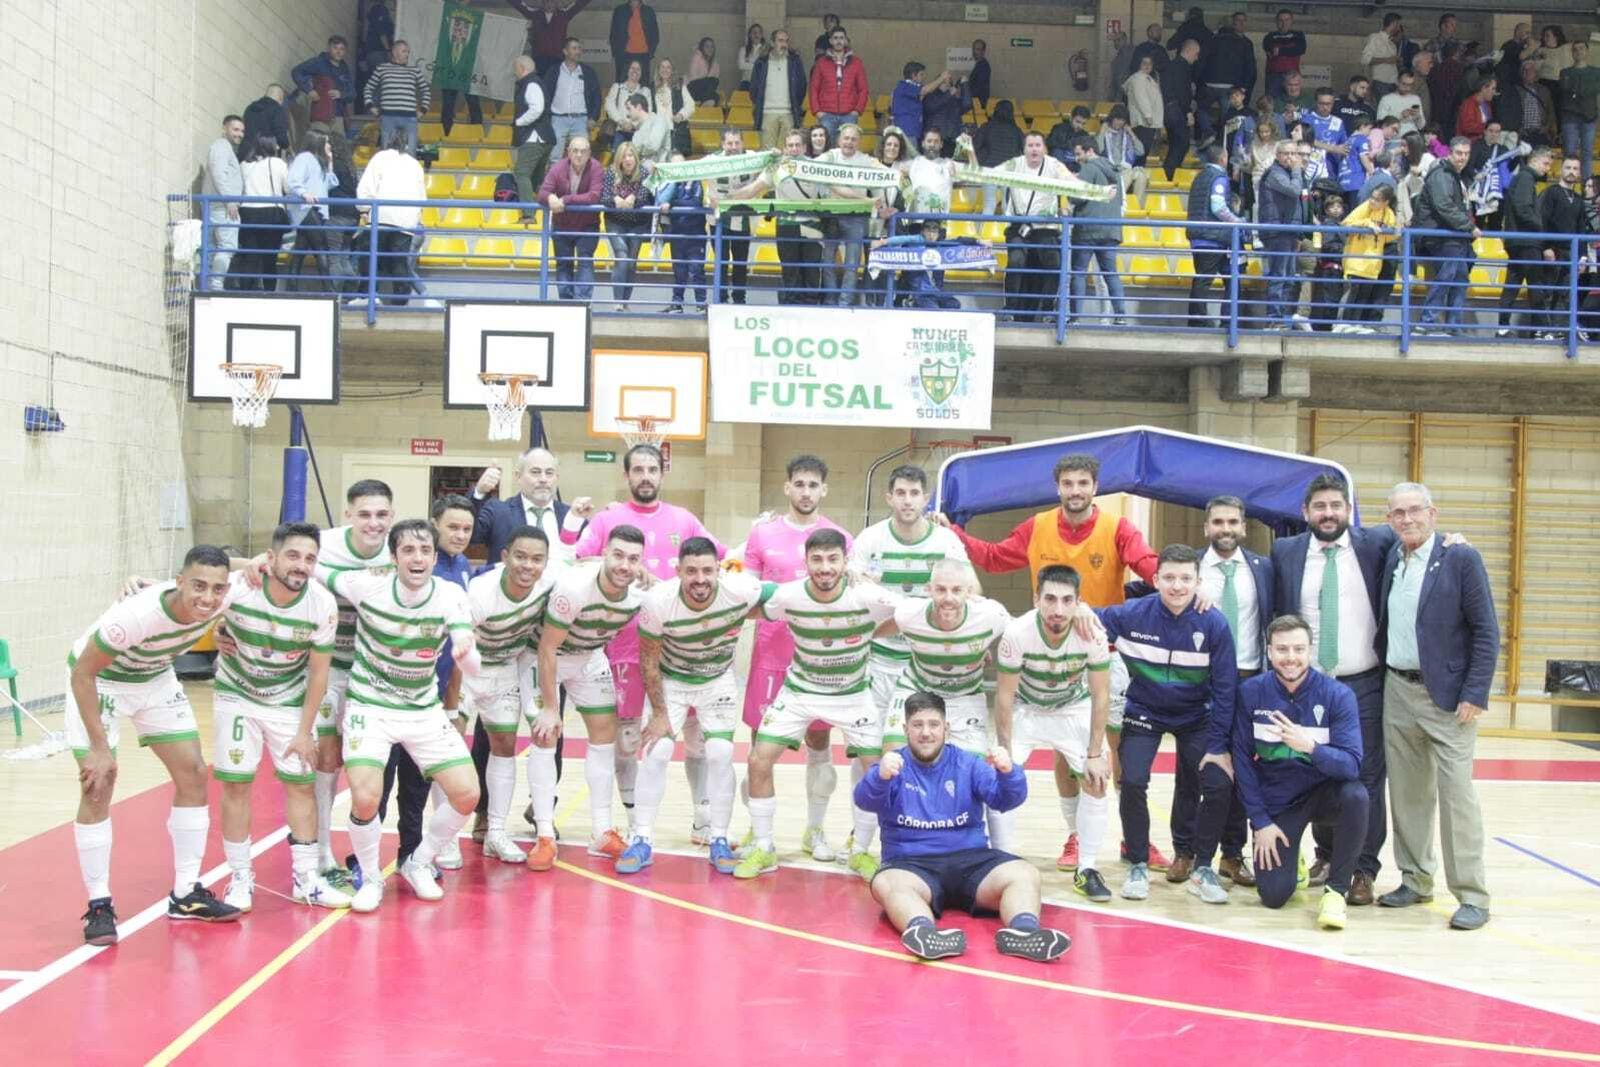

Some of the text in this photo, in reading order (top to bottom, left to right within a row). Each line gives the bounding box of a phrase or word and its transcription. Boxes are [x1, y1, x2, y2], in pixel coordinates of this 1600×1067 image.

[857, 170, 897, 182] FUTSAL
[734, 316, 771, 331] LOS
[911, 327, 968, 341] NUNCA
[754, 335, 860, 361] LOCOS
[778, 362, 818, 378] DEL
[749, 381, 893, 410] FUTSAL
[916, 408, 960, 419] SOLOS
[231, 715, 244, 742] 6
[956, 811, 969, 826] CF
